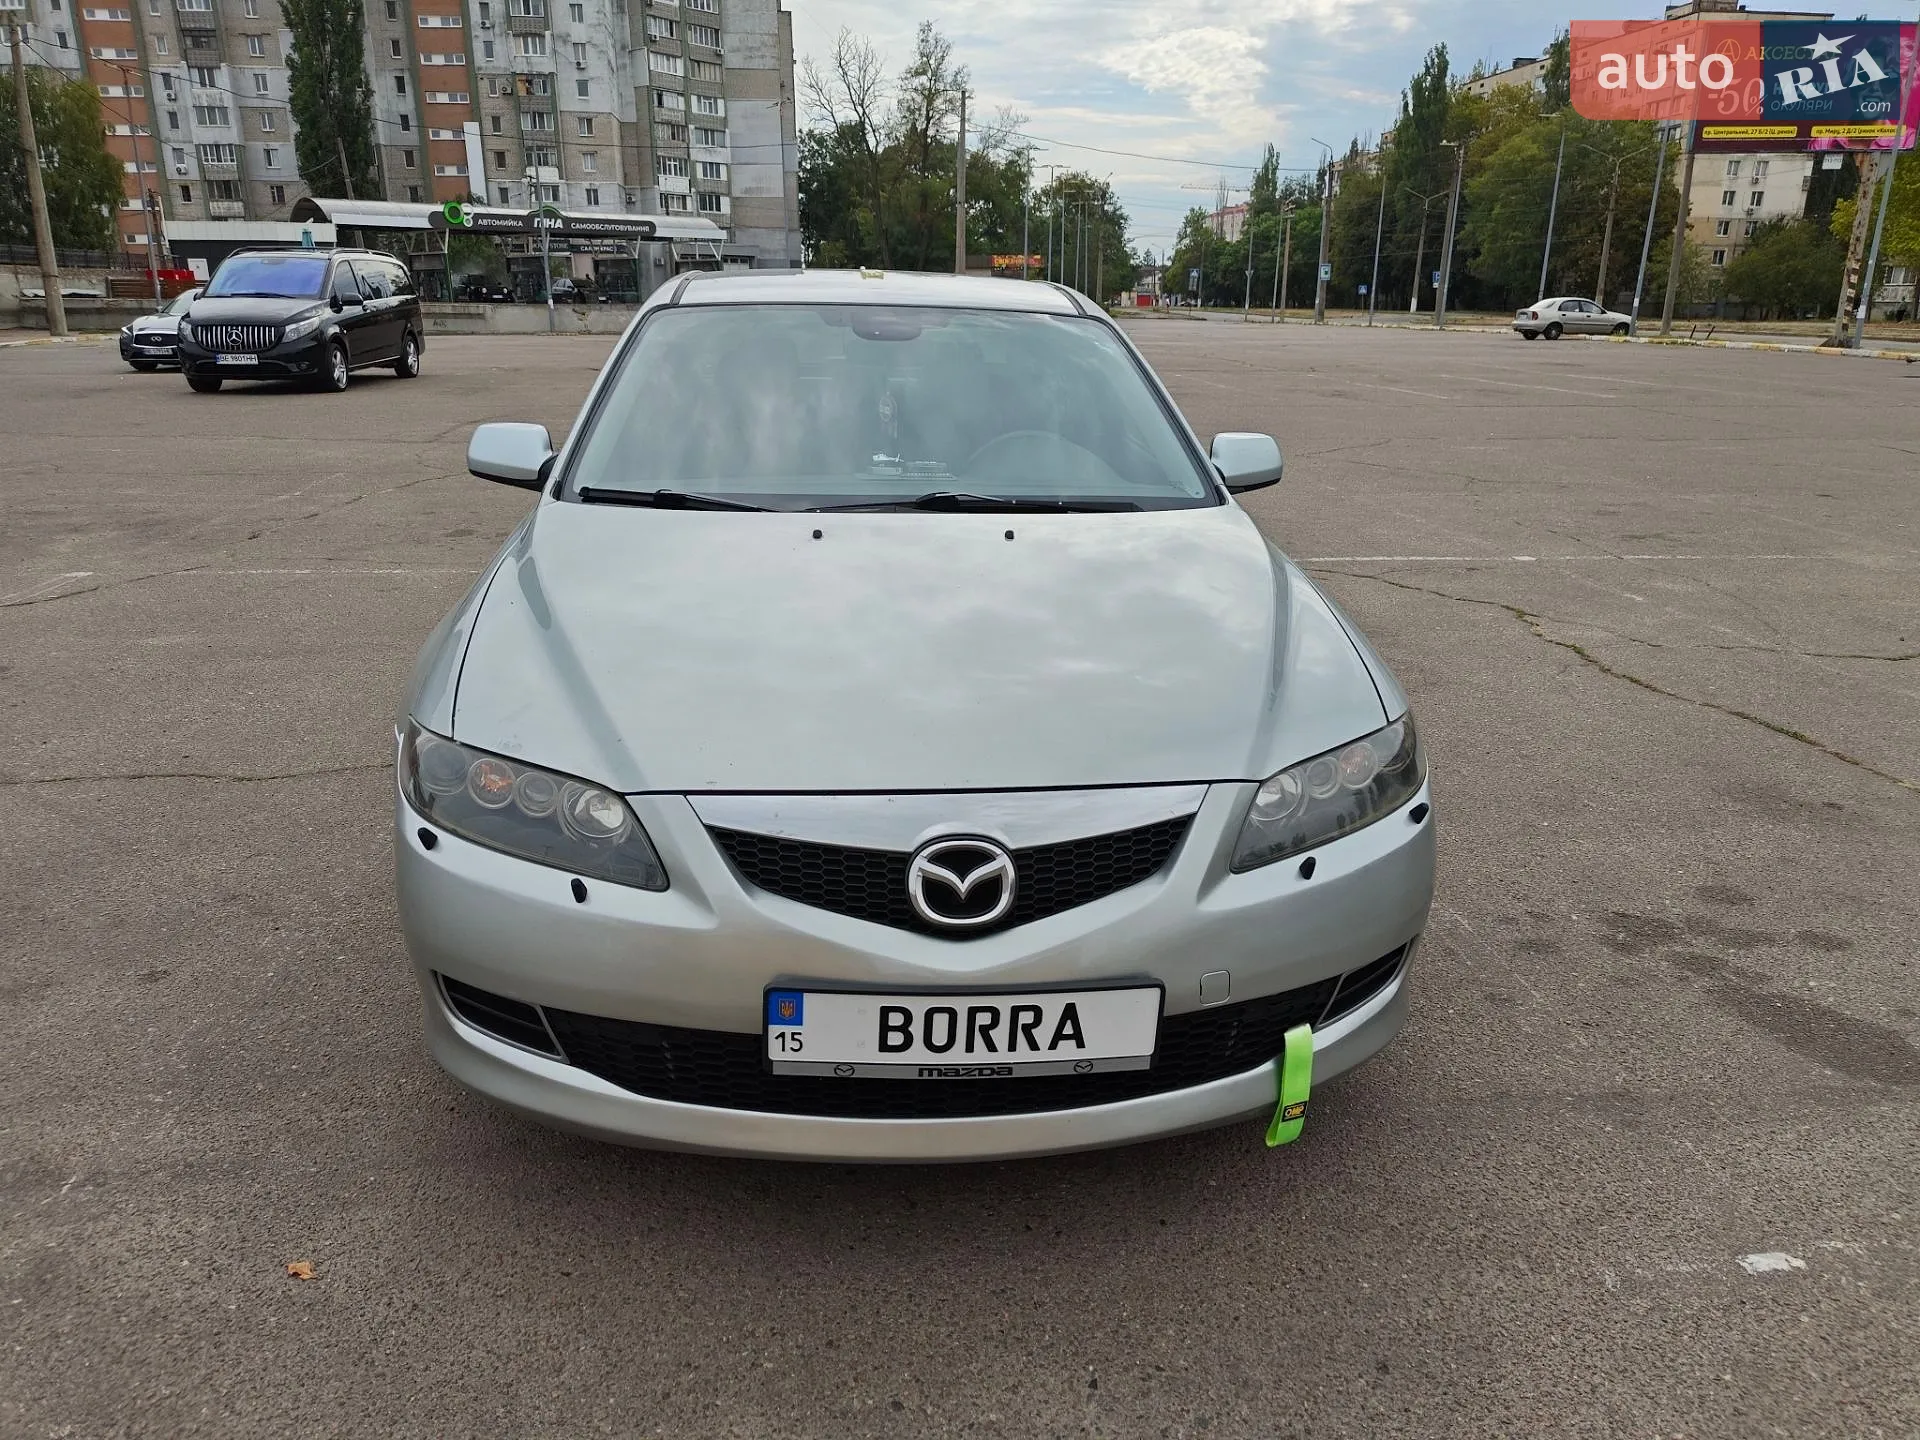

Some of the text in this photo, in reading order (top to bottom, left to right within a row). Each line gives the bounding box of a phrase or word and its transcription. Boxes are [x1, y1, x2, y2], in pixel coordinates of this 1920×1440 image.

[477, 218, 523, 227] АВТОМИЙКА
[877, 1002, 1086, 1054] BORRA
[775, 1031, 803, 1053] 15
[918, 1065, 1013, 1078] mazda
